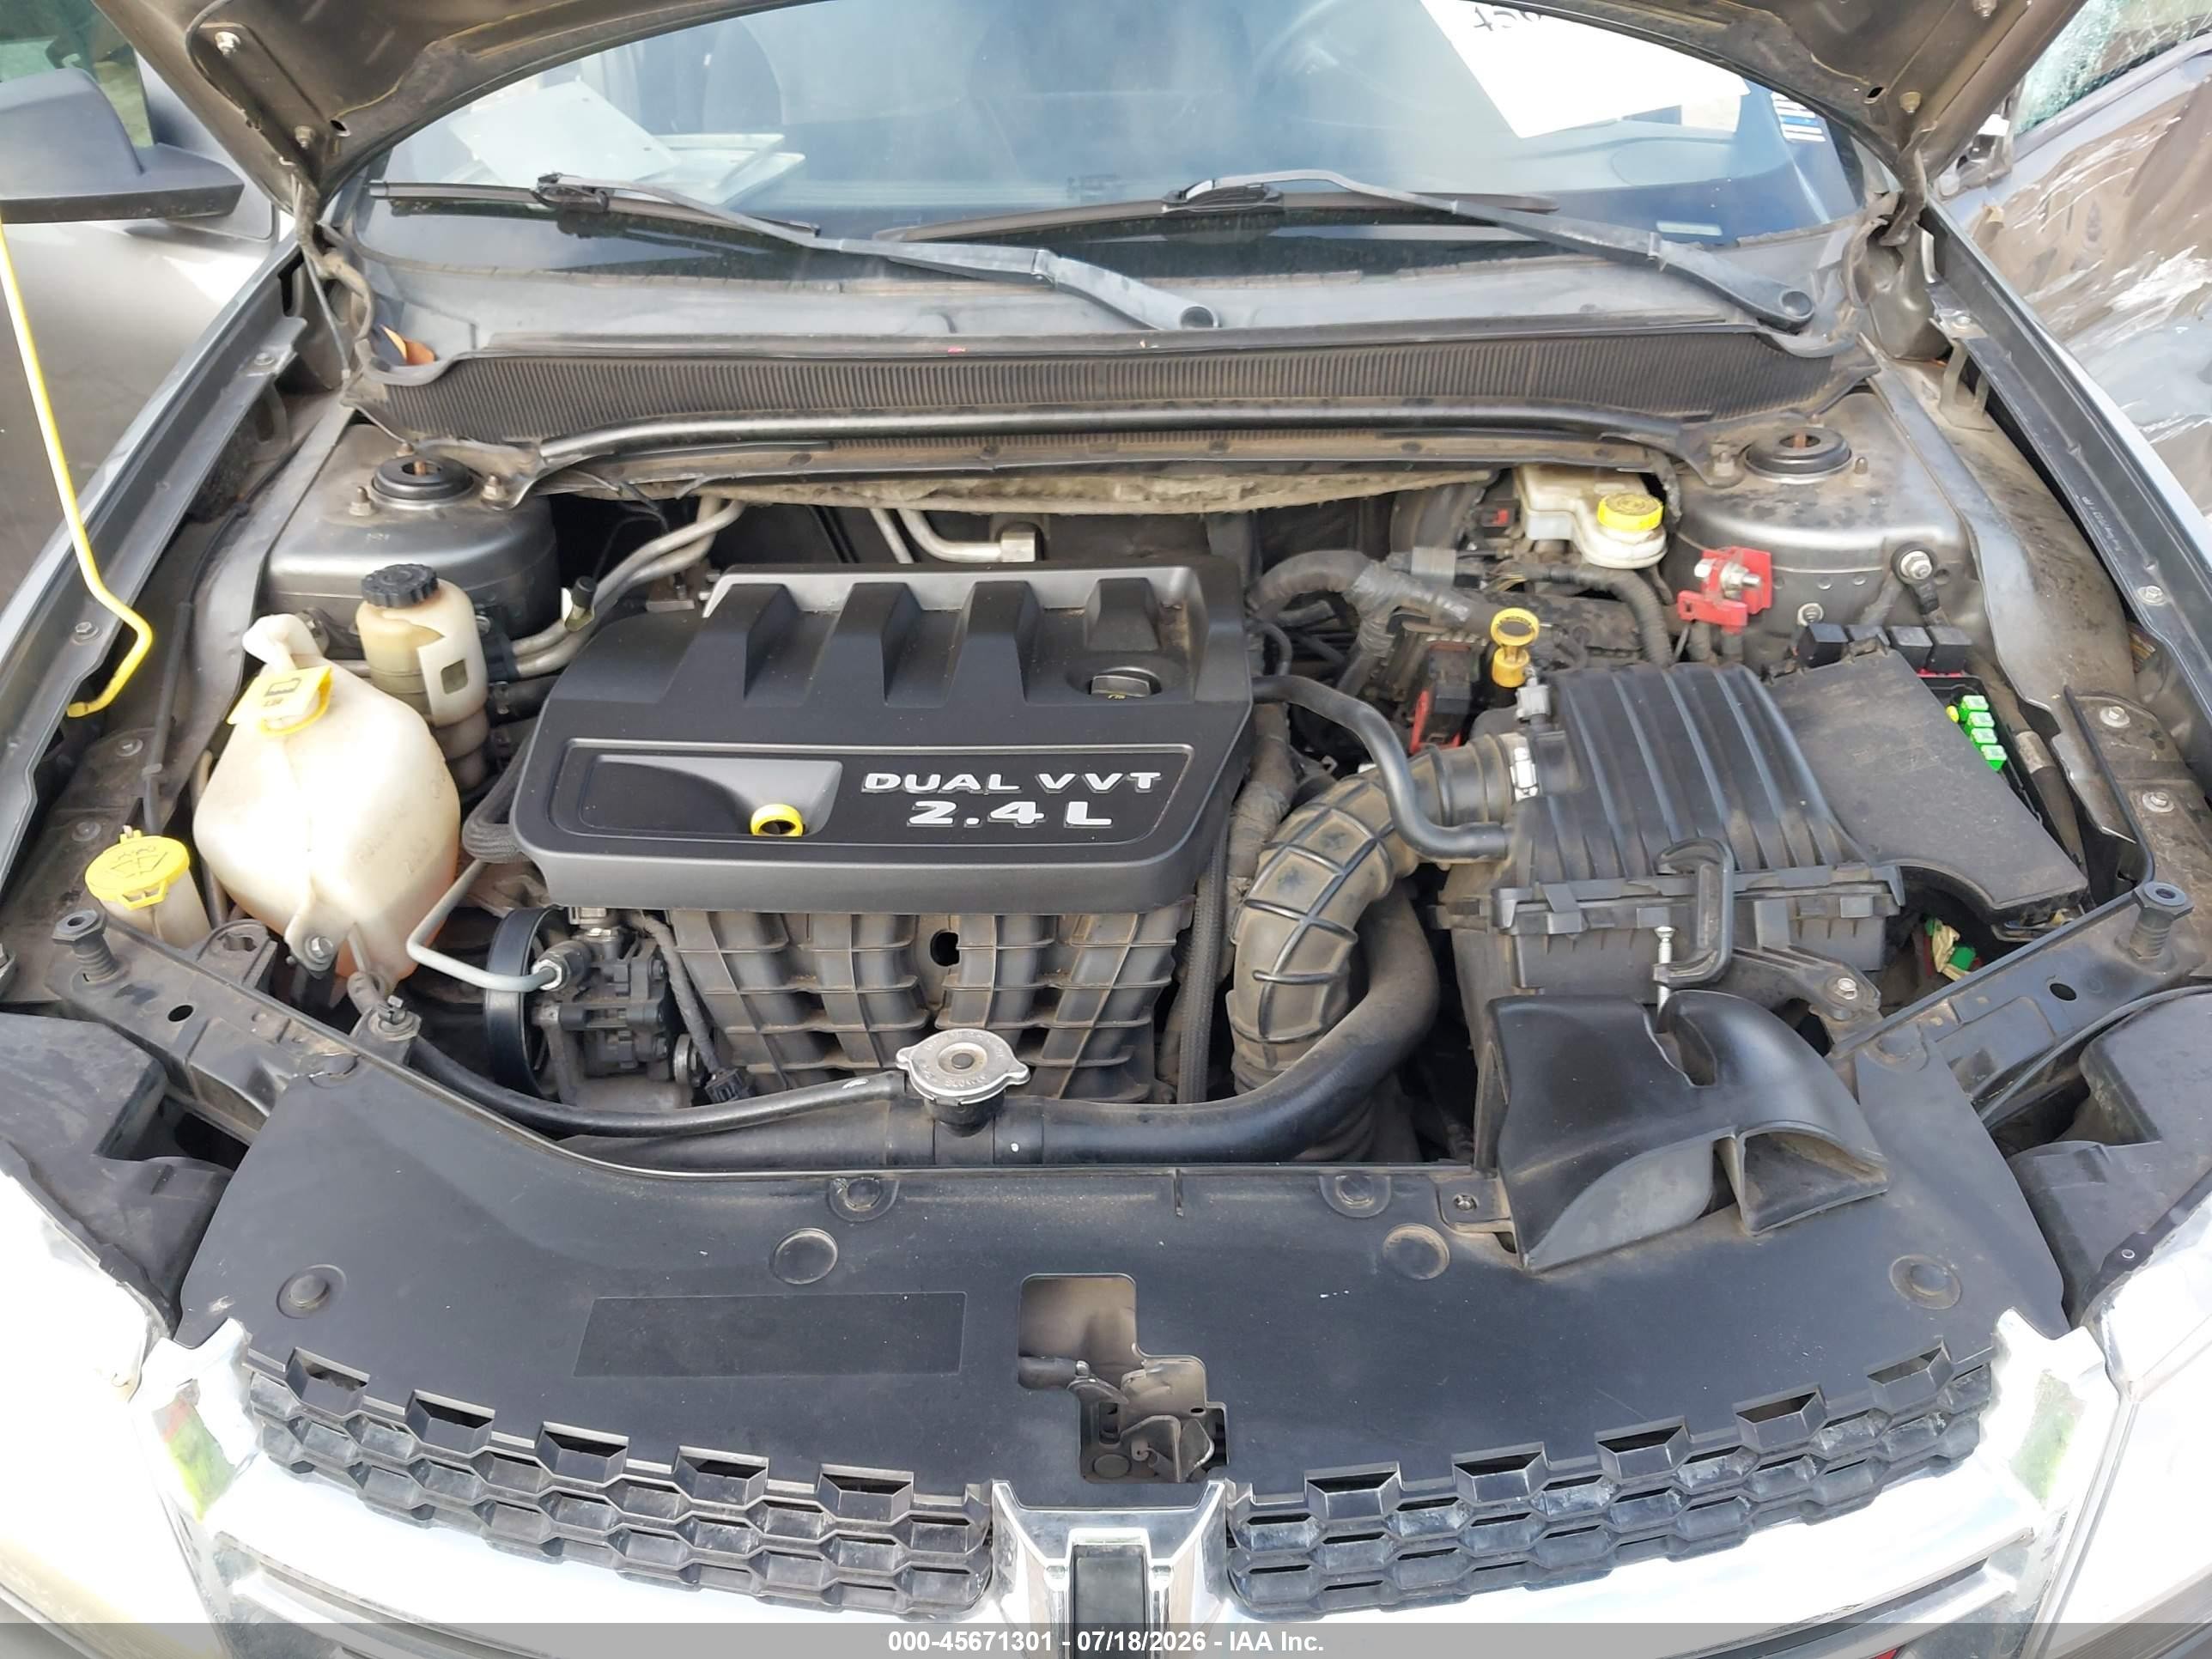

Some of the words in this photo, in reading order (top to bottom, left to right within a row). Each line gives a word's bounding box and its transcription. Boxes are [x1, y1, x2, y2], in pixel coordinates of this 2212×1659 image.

[862, 773, 1022, 793] DUAL
[1036, 772, 1162, 793] VVT
[907, 800, 1047, 828] 2.4
[1065, 801, 1113, 828] L
